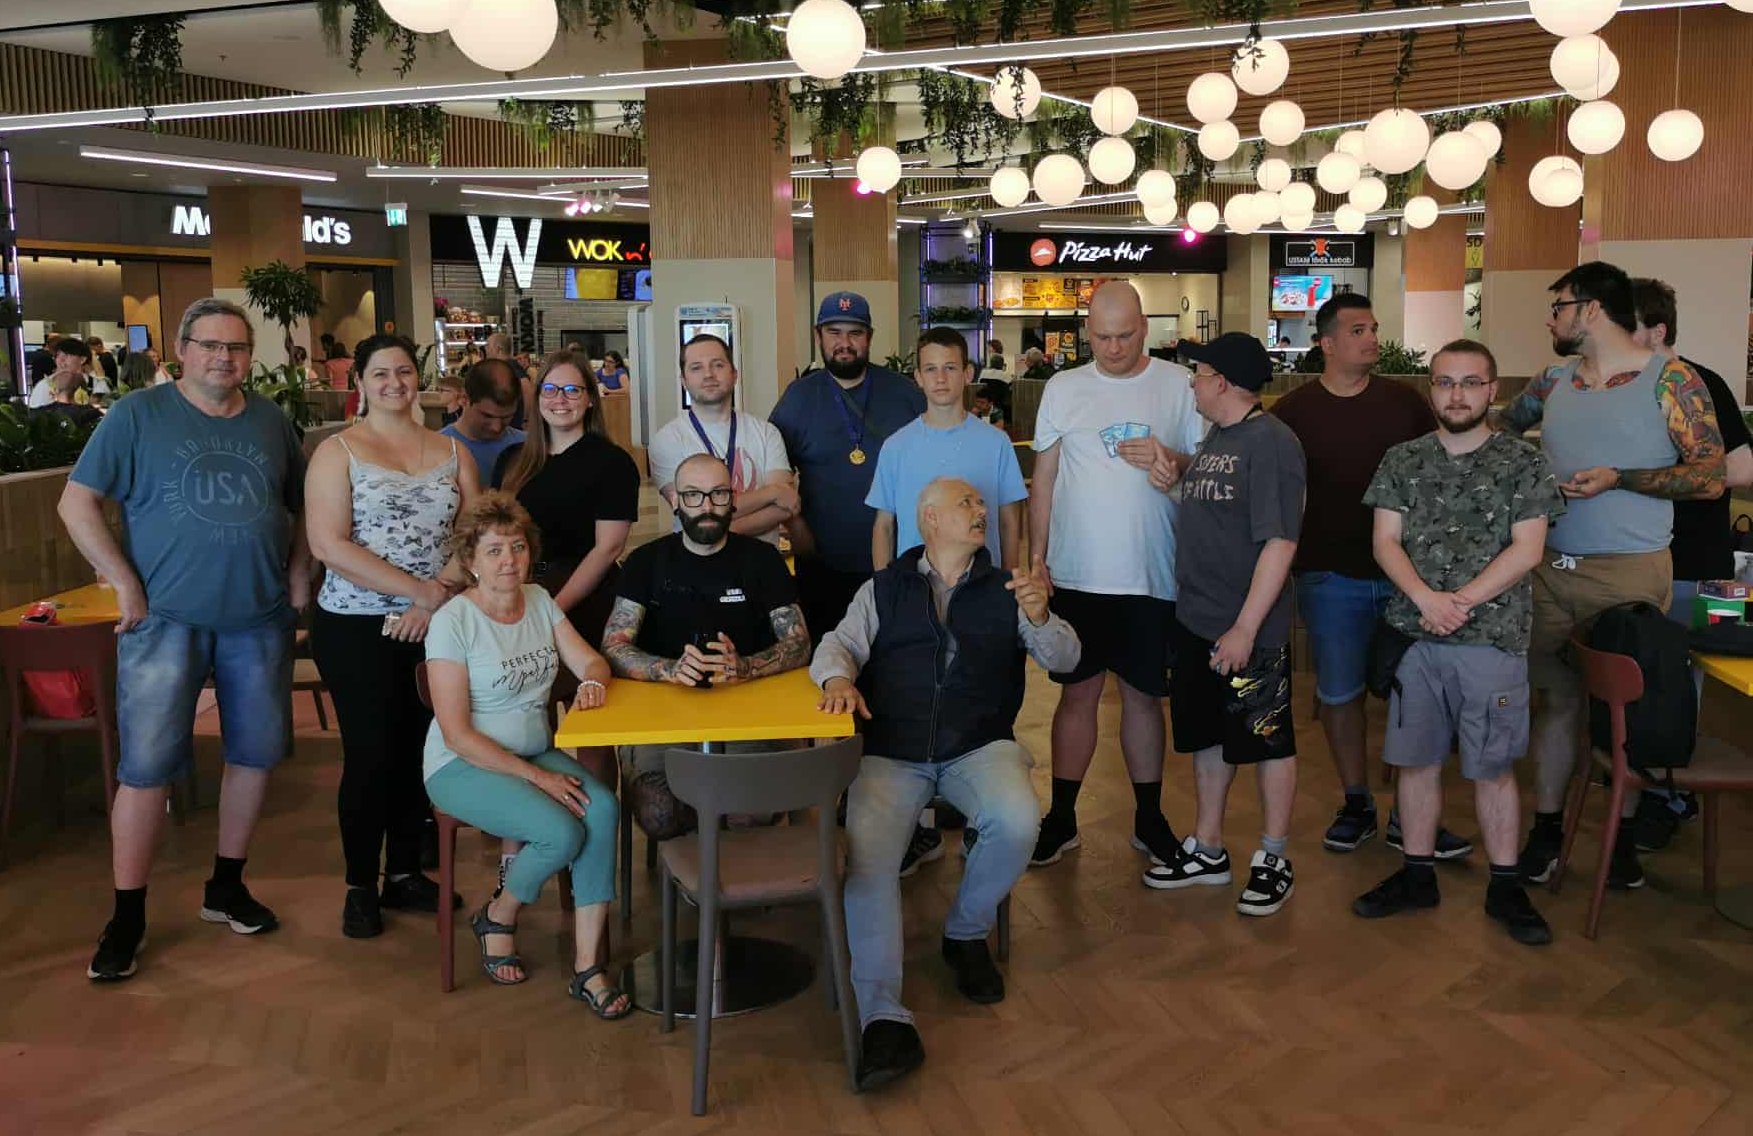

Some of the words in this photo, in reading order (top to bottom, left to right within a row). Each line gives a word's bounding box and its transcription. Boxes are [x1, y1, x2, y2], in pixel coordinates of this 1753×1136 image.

[466, 215, 543, 289] W
[568, 239, 624, 261] WOK
[1058, 240, 1111, 264] Pizza
[1111, 241, 1153, 262] Hut
[194, 470, 259, 507] USA
